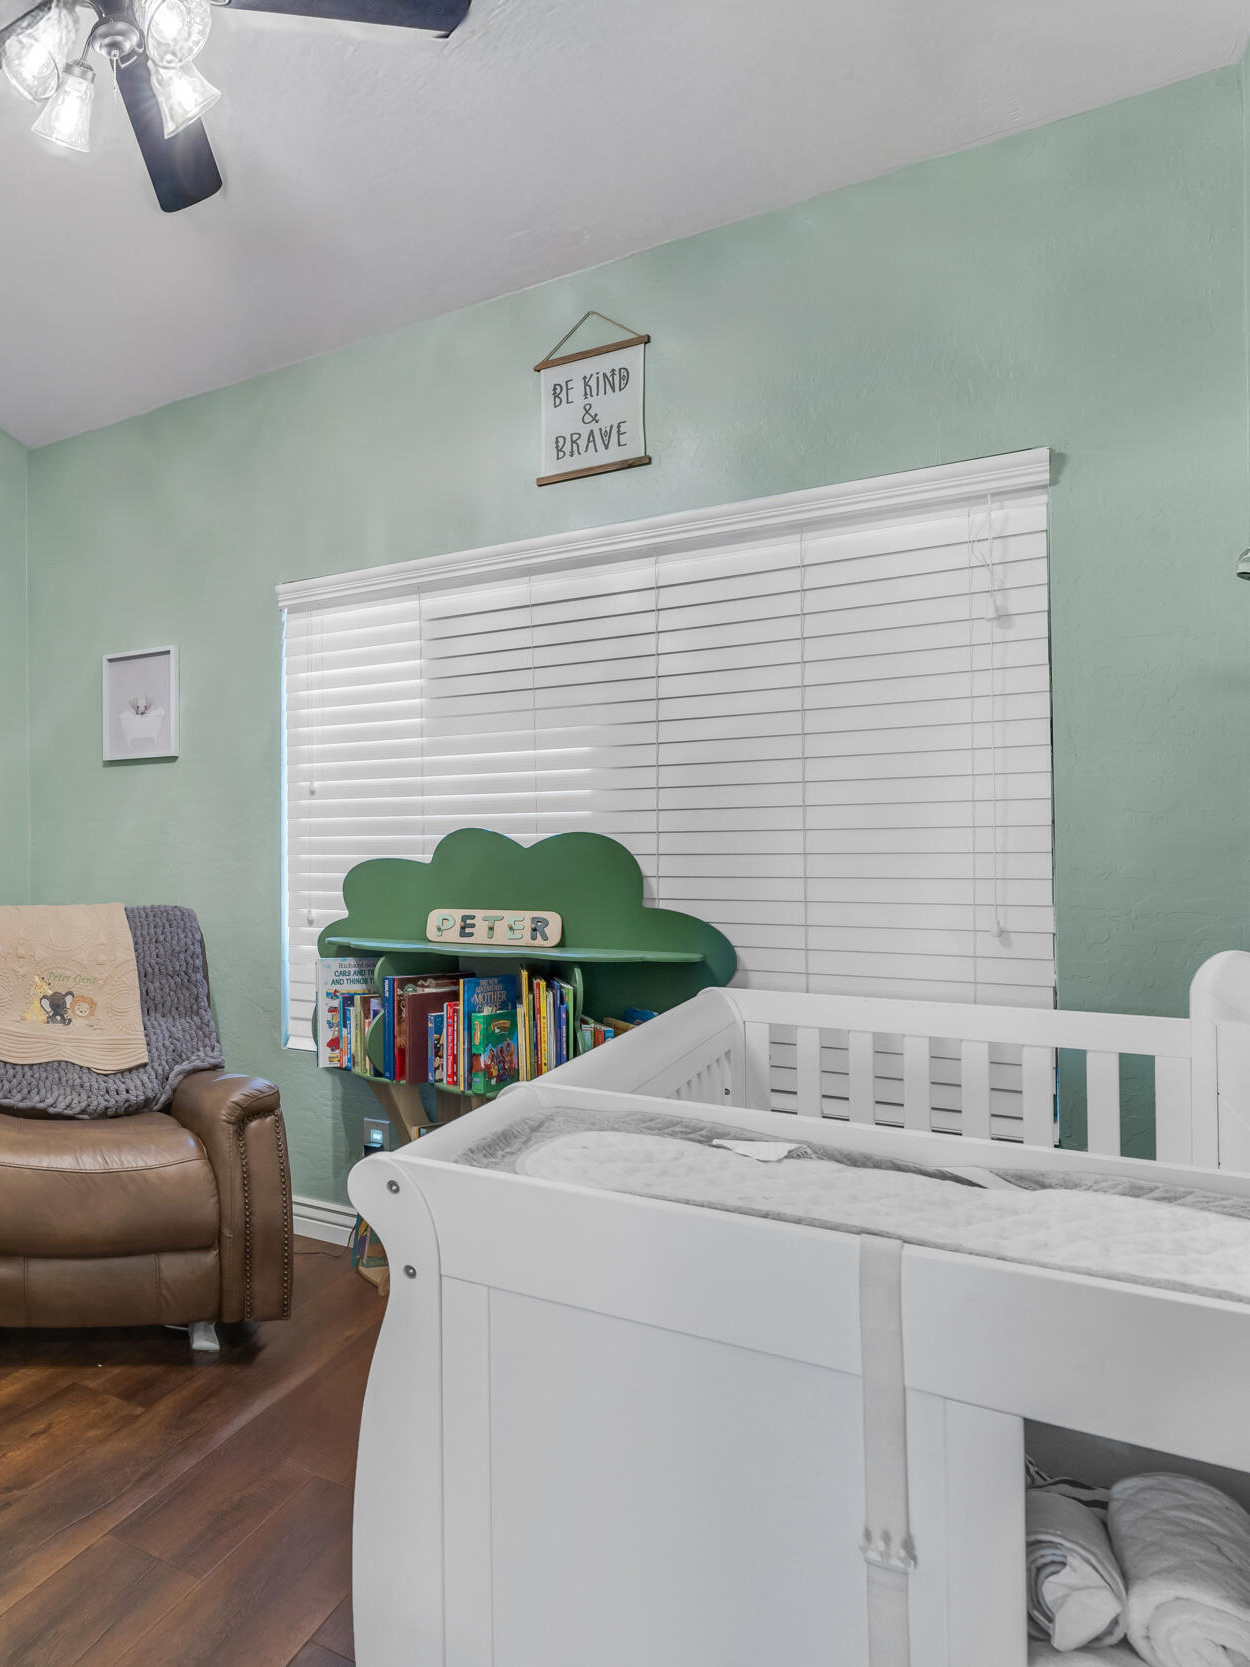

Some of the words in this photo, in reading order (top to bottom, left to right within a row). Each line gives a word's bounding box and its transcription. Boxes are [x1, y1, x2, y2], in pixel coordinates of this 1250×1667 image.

[552, 378, 575, 408] BE
[581, 402, 600, 425] &
[554, 420, 628, 461] BRAVE
[436, 913, 550, 942] PETER
[46, 971, 71, 982] Peter
[330, 978, 345, 986] AND
[346, 977, 368, 985] THINGS
[334, 969, 351, 978] CARS
[474, 991, 507, 1004] MOTHER
